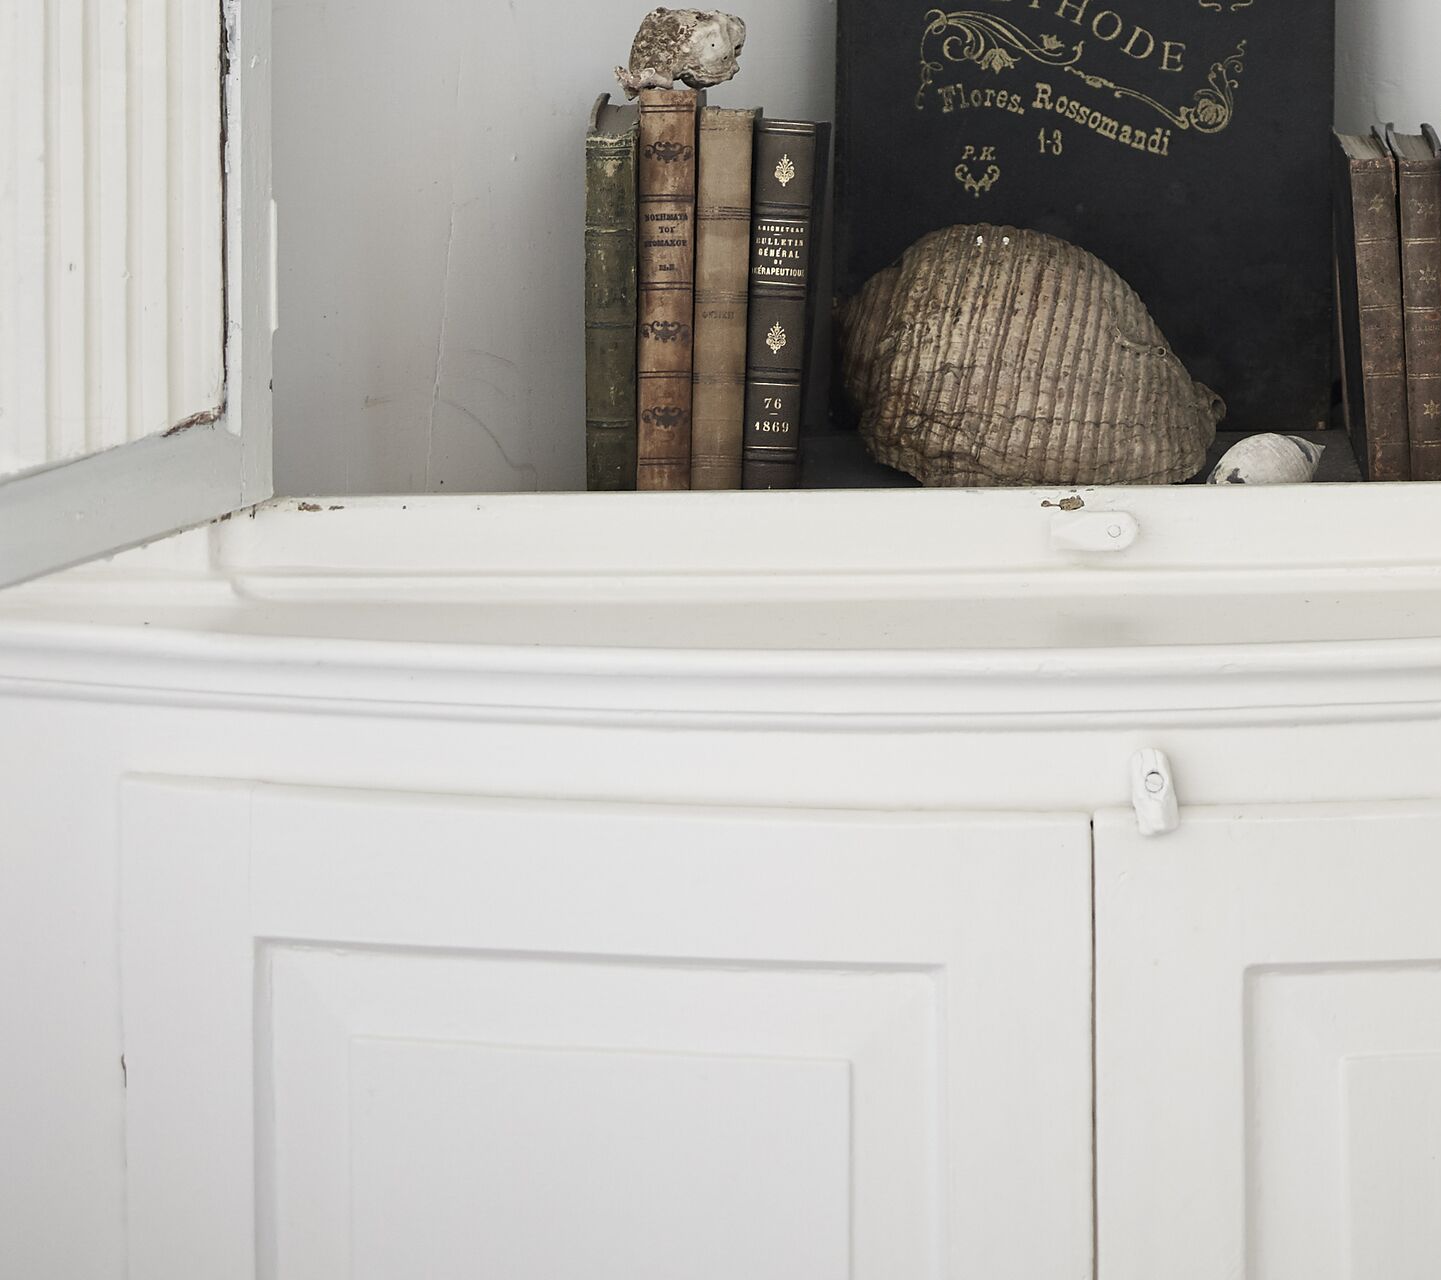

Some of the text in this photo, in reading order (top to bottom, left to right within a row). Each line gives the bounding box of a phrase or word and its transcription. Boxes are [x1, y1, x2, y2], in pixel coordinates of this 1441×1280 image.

[1032, 82, 1172, 157] Rossomandi
[1038, 127, 1064, 156] 1-3
[758, 247, 800, 259] GÉNÉRAL
[764, 397, 782, 410] 76
[755, 421, 789, 433] 1869
